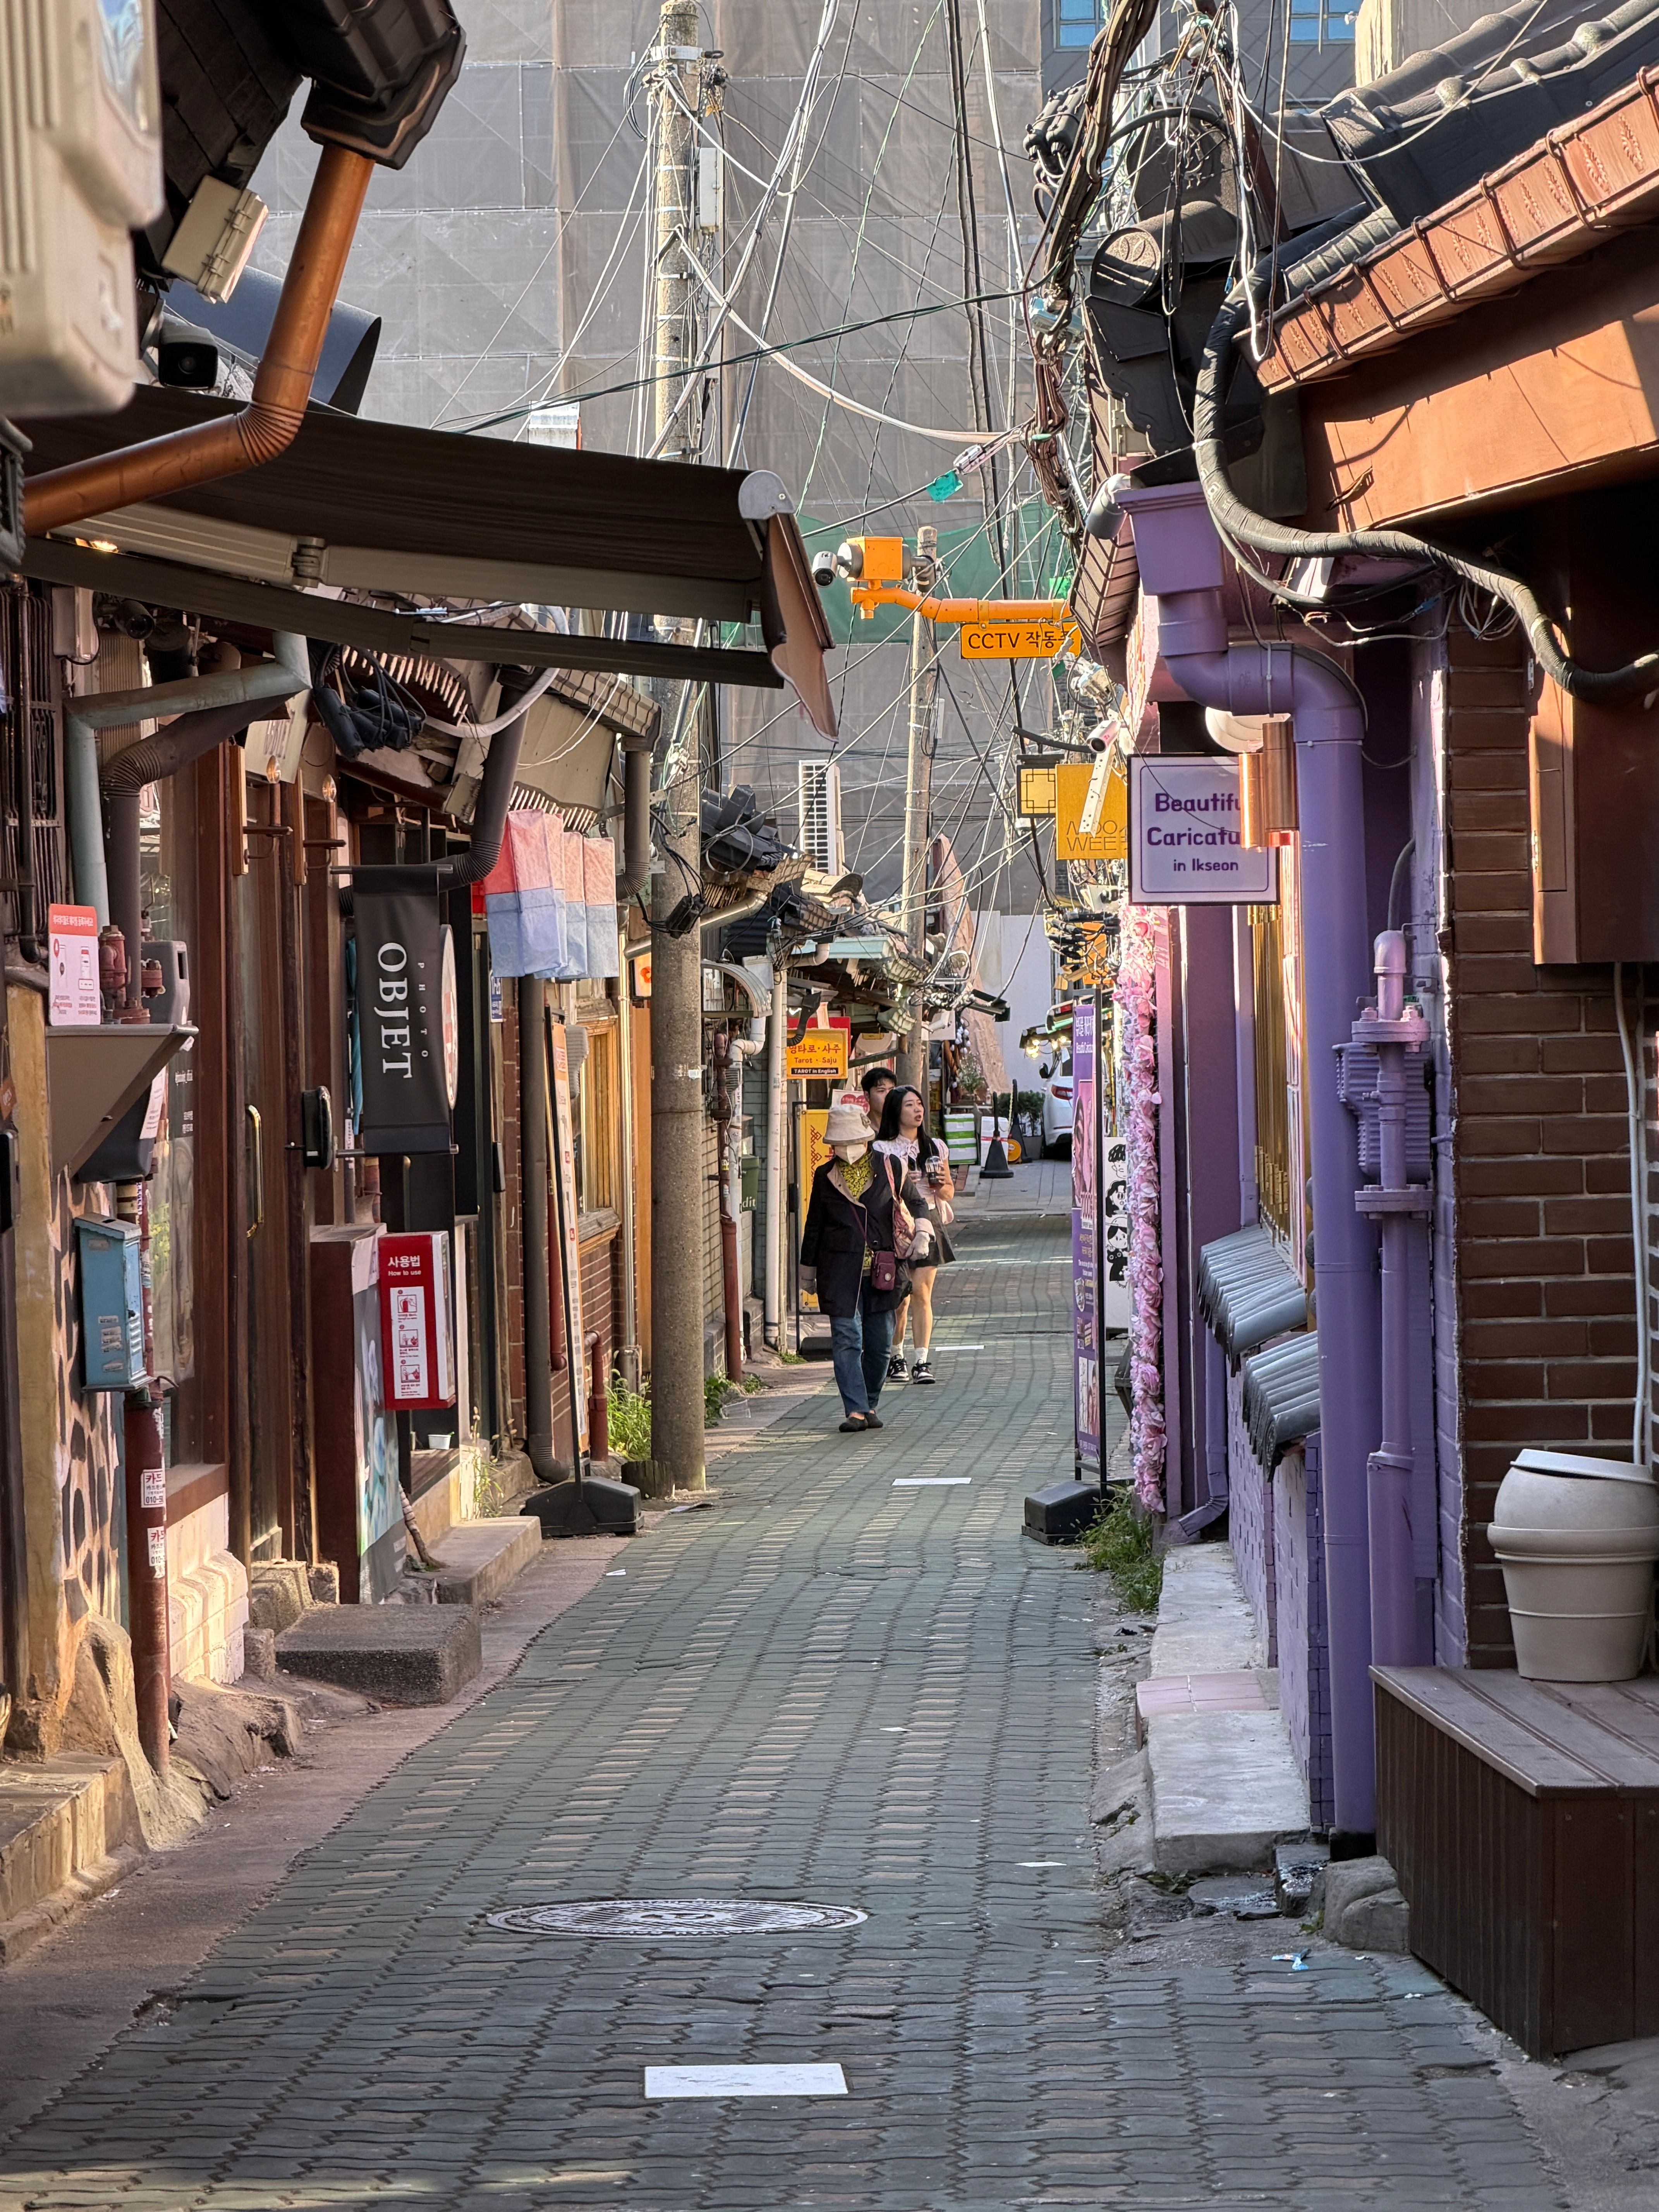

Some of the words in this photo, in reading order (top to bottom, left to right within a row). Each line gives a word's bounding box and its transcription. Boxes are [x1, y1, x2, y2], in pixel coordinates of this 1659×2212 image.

[968, 633, 1020, 649] CCTV
[1174, 859, 1186, 871] in
[1192, 859, 1238, 871] Ikseon
[374, 943, 412, 1078] OBJET
[417, 962, 428, 1057] PHOTO
[388, 1255, 421, 1268] 사용법
